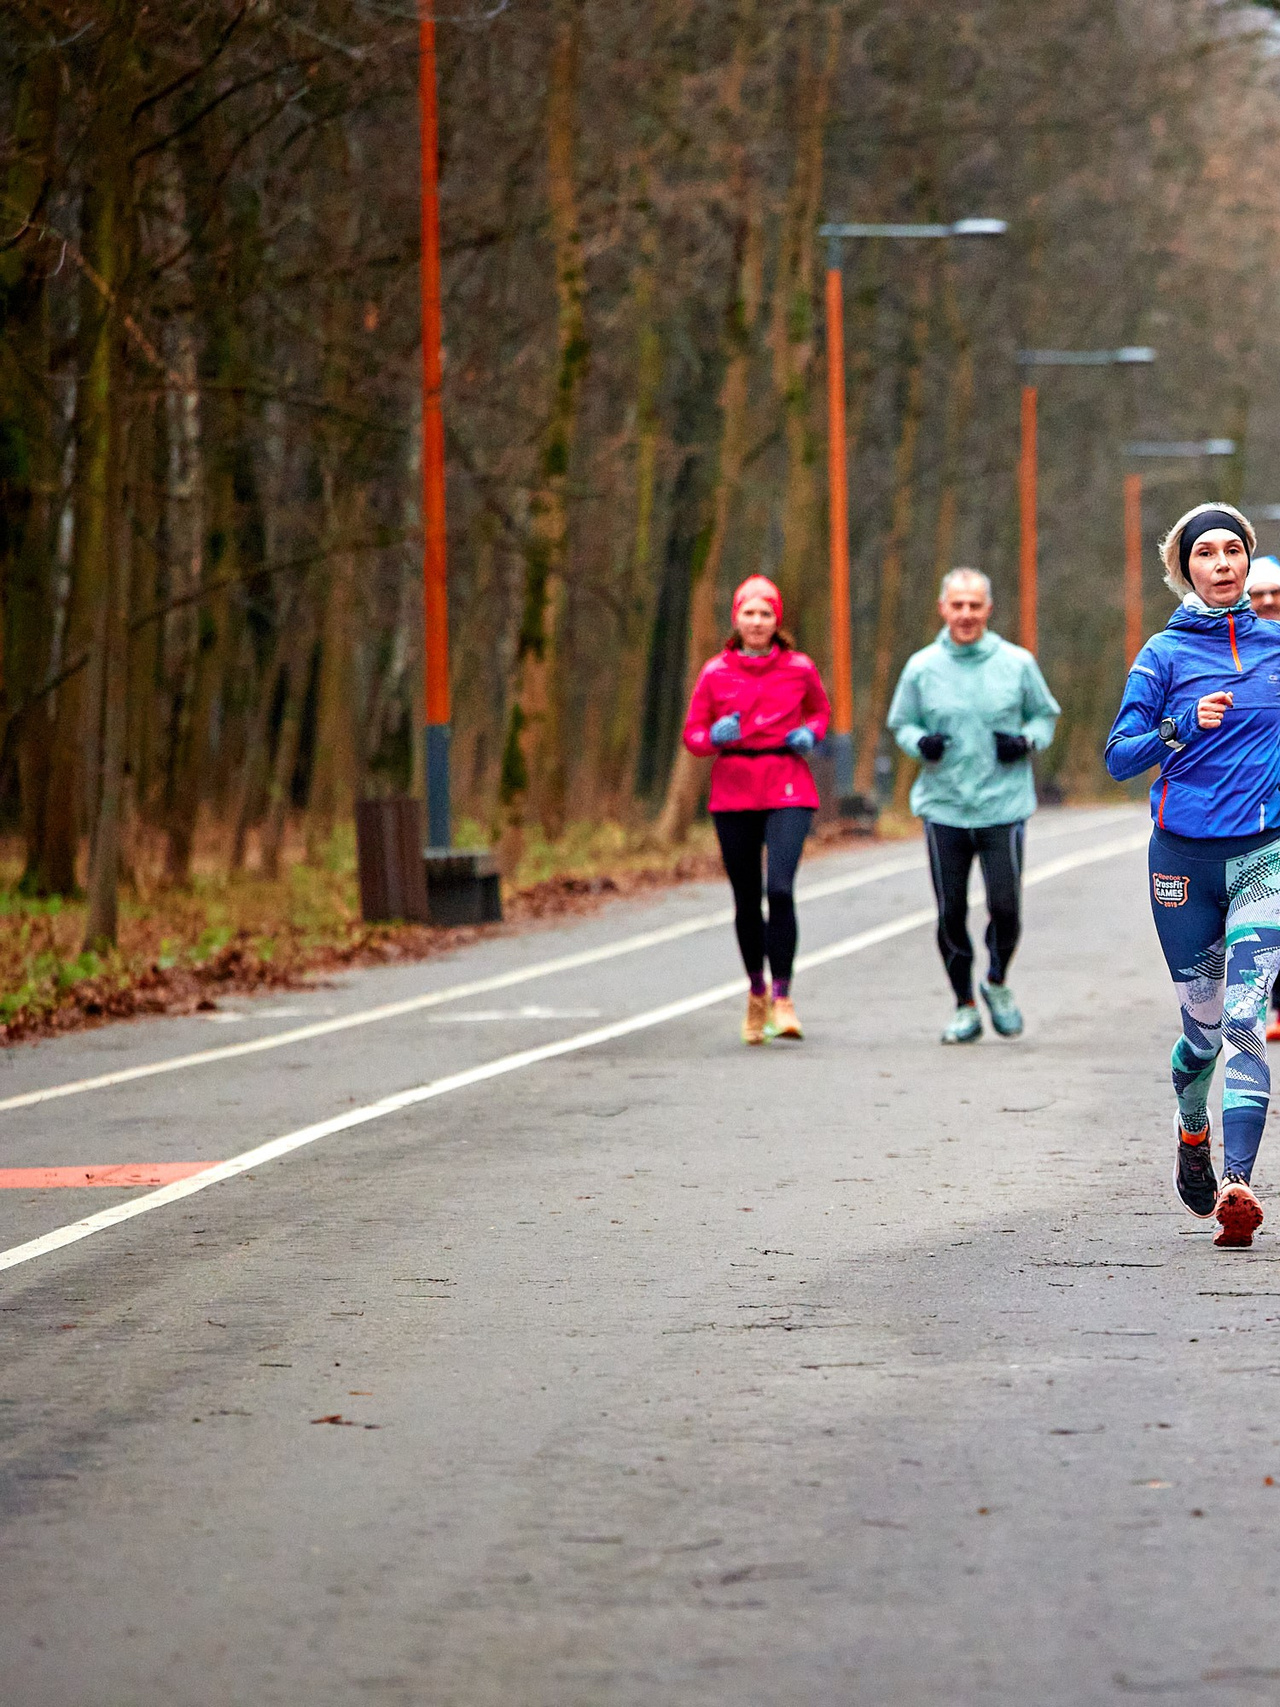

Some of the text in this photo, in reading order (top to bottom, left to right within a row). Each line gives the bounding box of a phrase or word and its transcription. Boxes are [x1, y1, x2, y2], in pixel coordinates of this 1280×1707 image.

[1158, 873, 1181, 881] Reebok
[1155, 878, 1184, 889] CrossFit
[1156, 888, 1183, 897] GAMES
